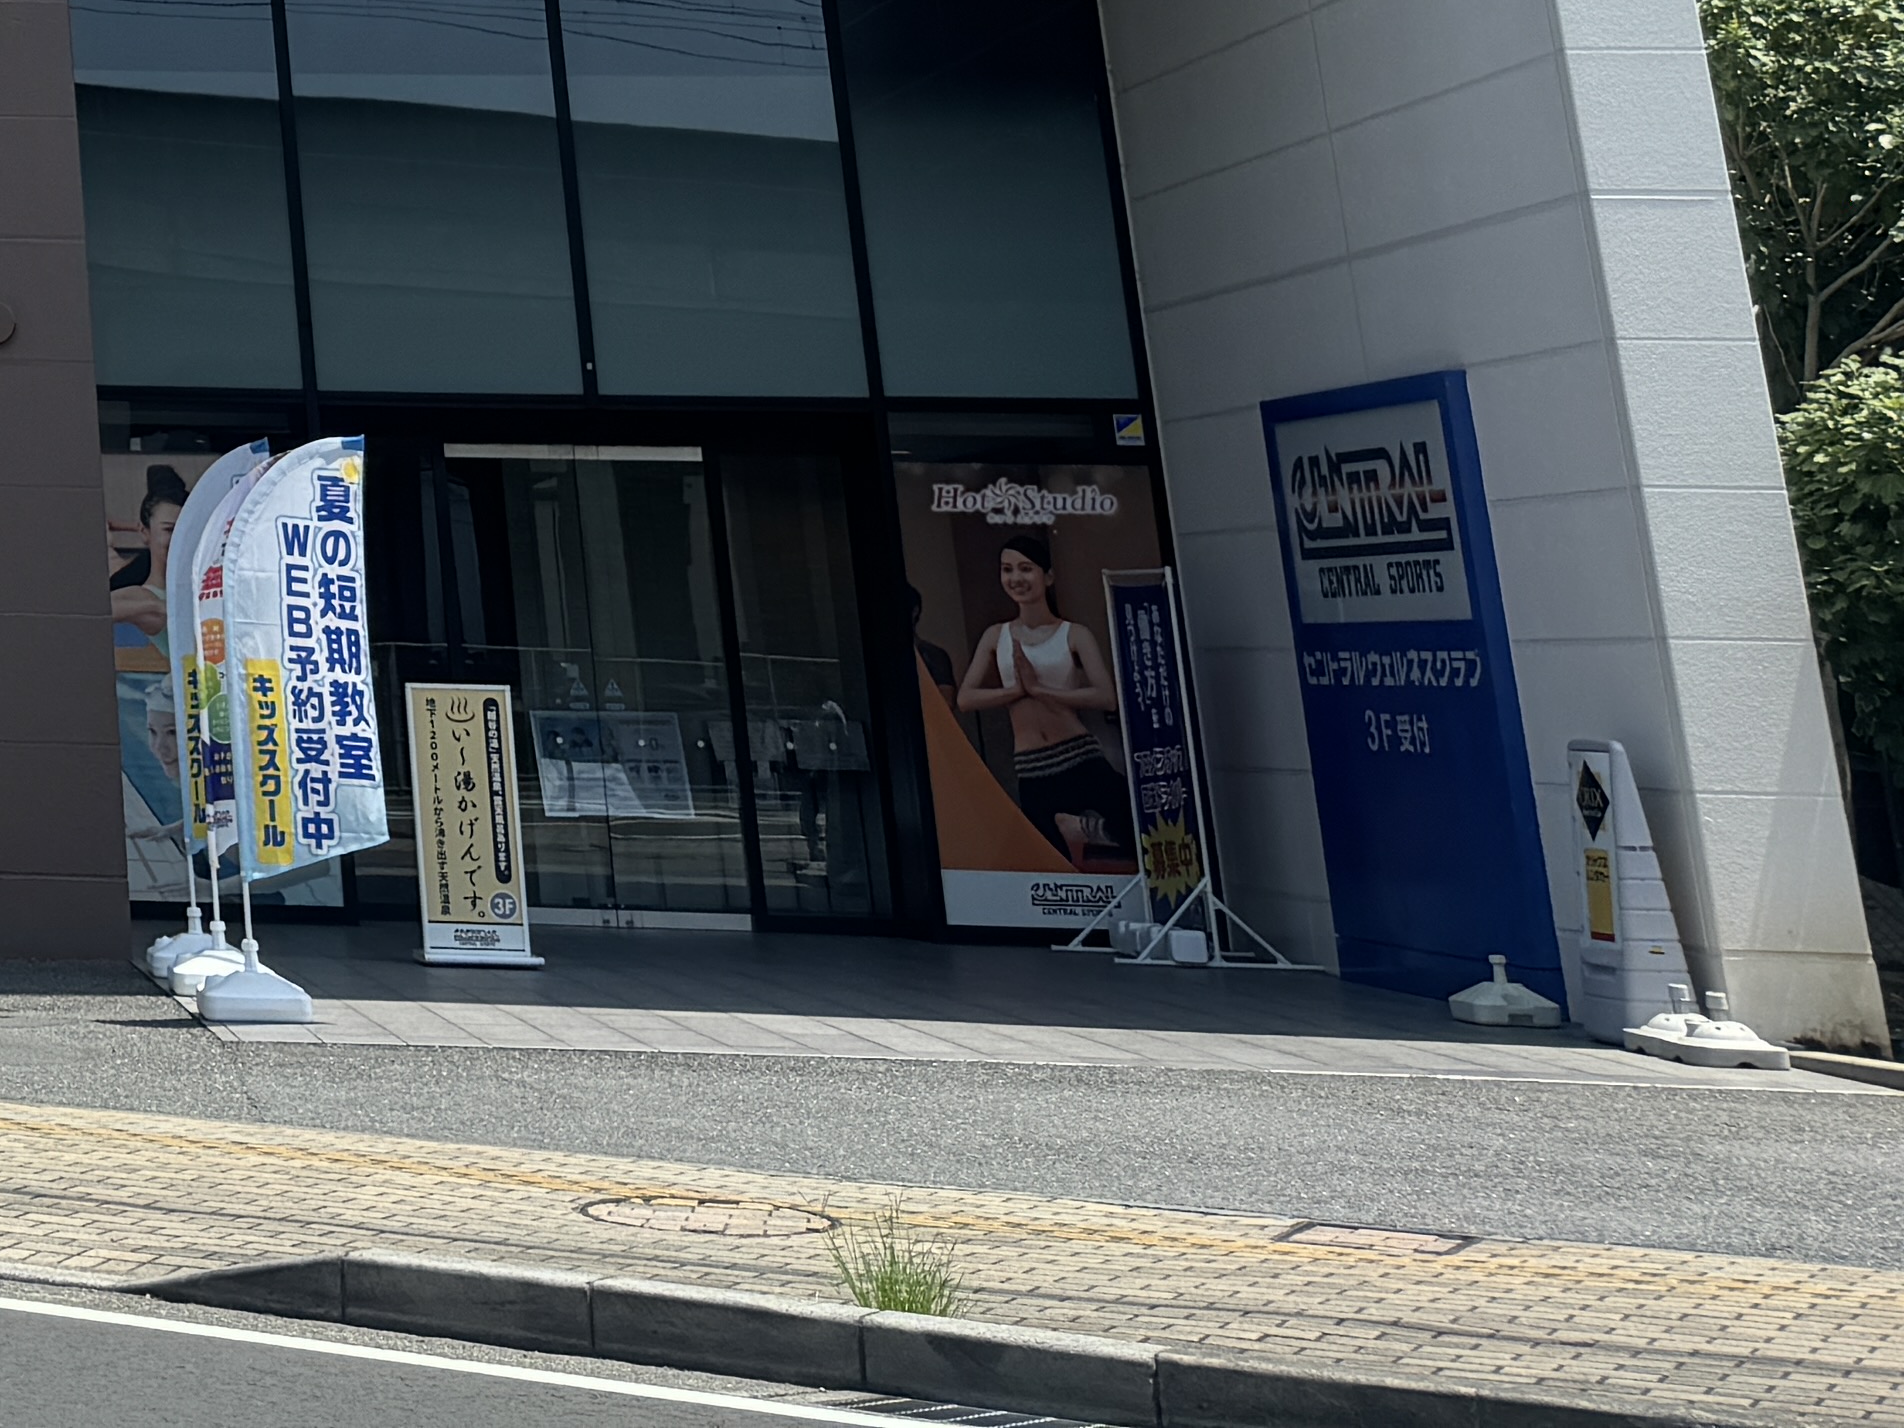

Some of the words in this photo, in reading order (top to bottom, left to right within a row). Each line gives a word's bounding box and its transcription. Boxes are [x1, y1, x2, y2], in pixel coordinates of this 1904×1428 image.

[932, 484, 989, 511] Hot
[1021, 485, 1117, 514] Studio
[1290, 440, 1454, 561] CENTRAL
[1319, 560, 1381, 598] CENTRAL
[1387, 558, 1445, 596] SPORTS
[315, 473, 377, 784] 夏の短期教室
[281, 521, 337, 853] WEB予約受付中
[1301, 647, 1483, 689] セントラルウェルネスクラブ
[1364, 709, 1393, 753] 3F
[1395, 713, 1431, 755] 受付
[251, 673, 286, 849] キッズスクール
[493, 896, 515, 916] 3F
